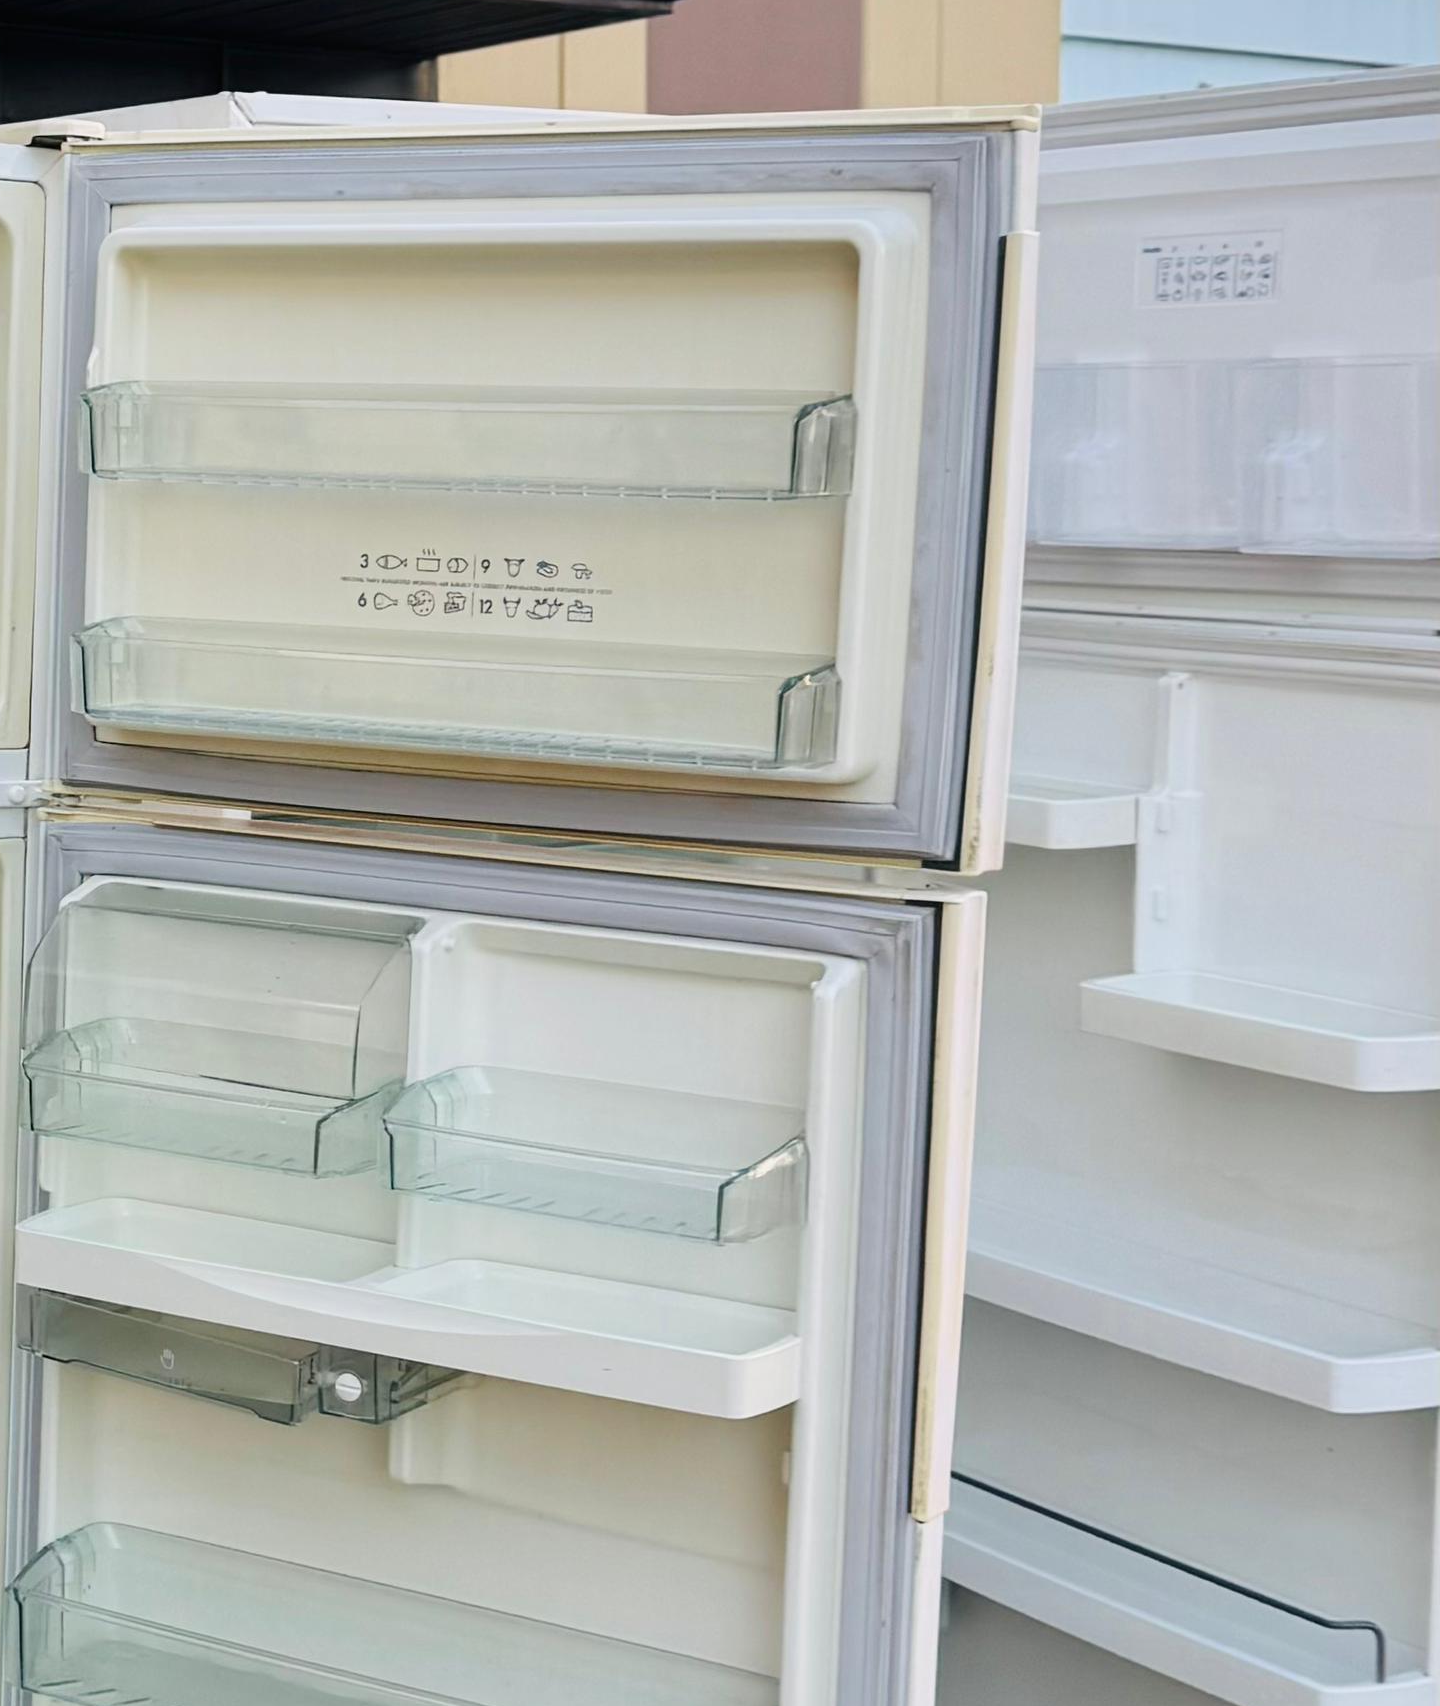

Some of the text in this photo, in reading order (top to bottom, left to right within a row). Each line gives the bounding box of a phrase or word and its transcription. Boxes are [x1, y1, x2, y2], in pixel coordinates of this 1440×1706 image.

[360, 553, 369, 569] 3
[481, 558, 491, 574] 9
[357, 592, 367, 607] 6
[479, 598, 493, 614] 12
